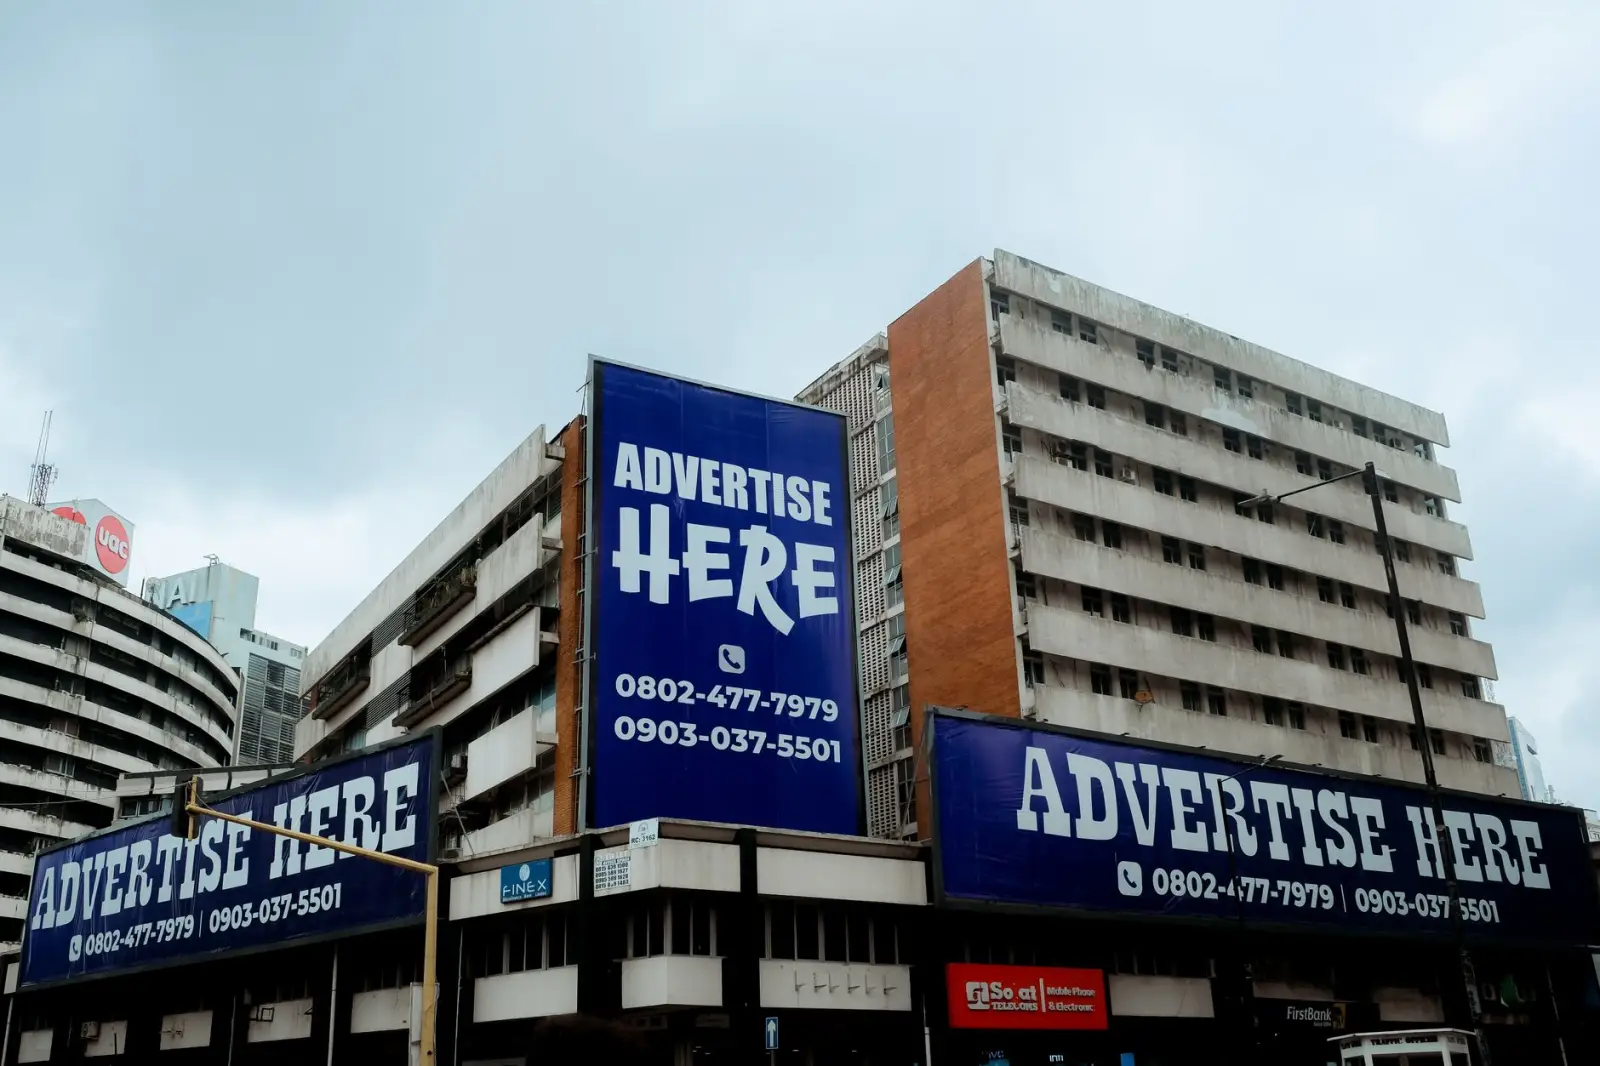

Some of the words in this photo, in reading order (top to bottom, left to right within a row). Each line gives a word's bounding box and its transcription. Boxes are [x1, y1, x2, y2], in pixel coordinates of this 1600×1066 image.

[613, 441, 833, 527] ADVERTISE
[612, 503, 839, 636] HERE
[615, 673, 839, 723] 0802-477-7979
[613, 715, 842, 763] 0903-037-5501
[1016, 746, 1394, 873] ADVERTISE
[1405, 805, 1551, 890] HERE
[31, 810, 254, 931] ADVERTISE
[269, 762, 420, 880] HERE
[502, 878, 547, 897] FINEX
[1152, 867, 1335, 910] 0802-477-7979
[1354, 887, 1500, 923] 0903-0375501
[85, 913, 195, 957] 0802-477-7979
[209, 882, 343, 934] 0903-037-5501
[1046, 986, 1072, 996] Mobile
[1048, 1001, 1055, 1011] &
[1286, 1005, 1332, 1021] FirstBank
